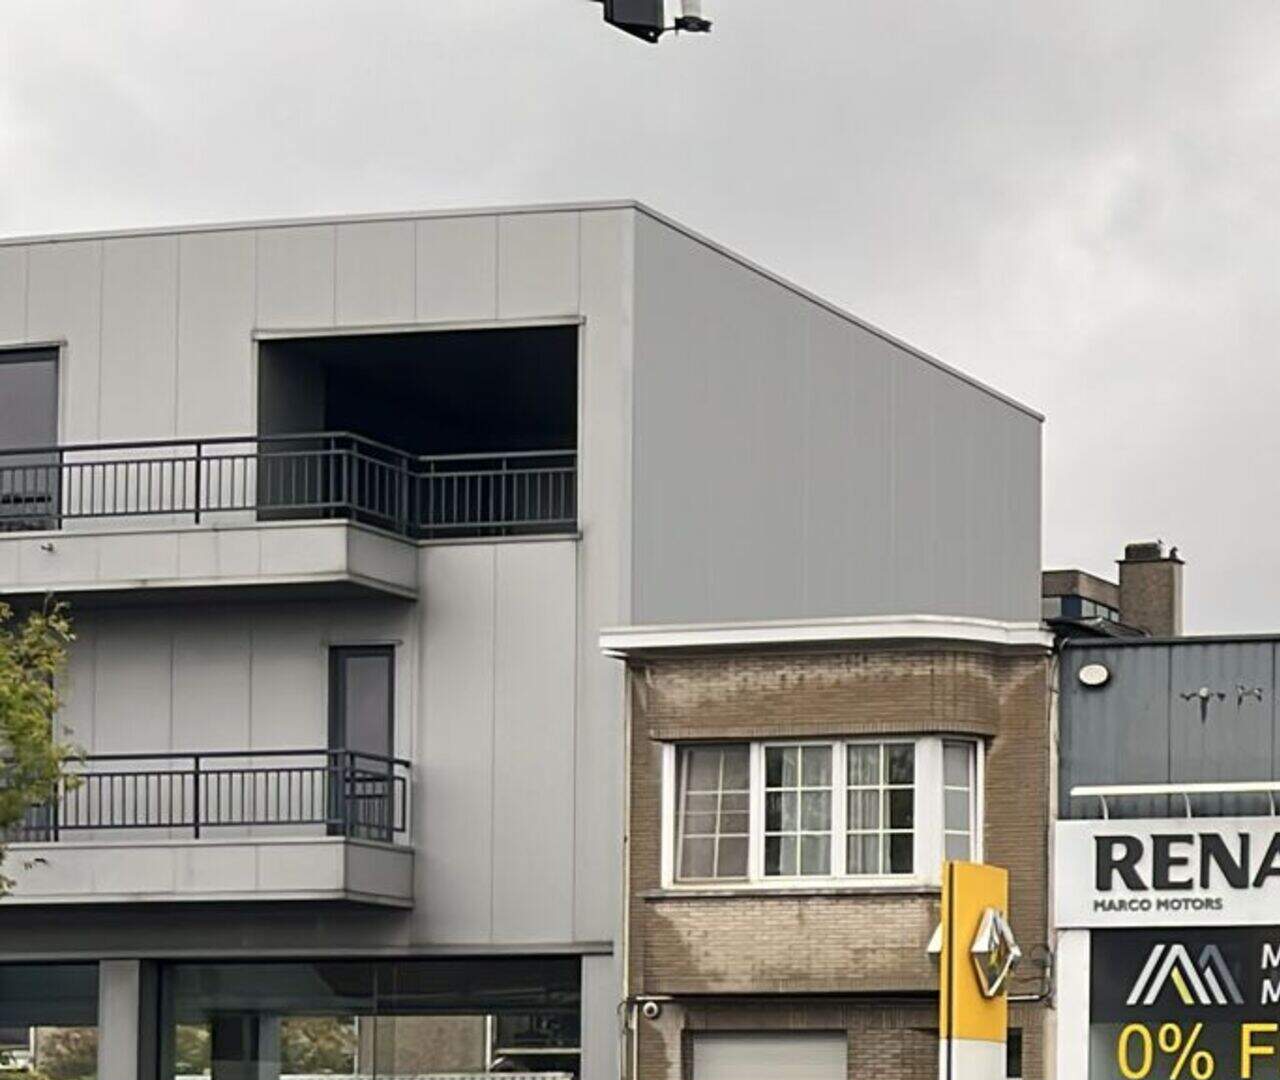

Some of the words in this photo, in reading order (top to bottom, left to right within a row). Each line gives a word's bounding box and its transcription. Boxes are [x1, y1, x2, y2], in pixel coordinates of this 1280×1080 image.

[1094, 899, 1152, 912] MARCO
[1156, 898, 1223, 910] MOTORS
[1118, 1022, 1215, 1080] 0%
